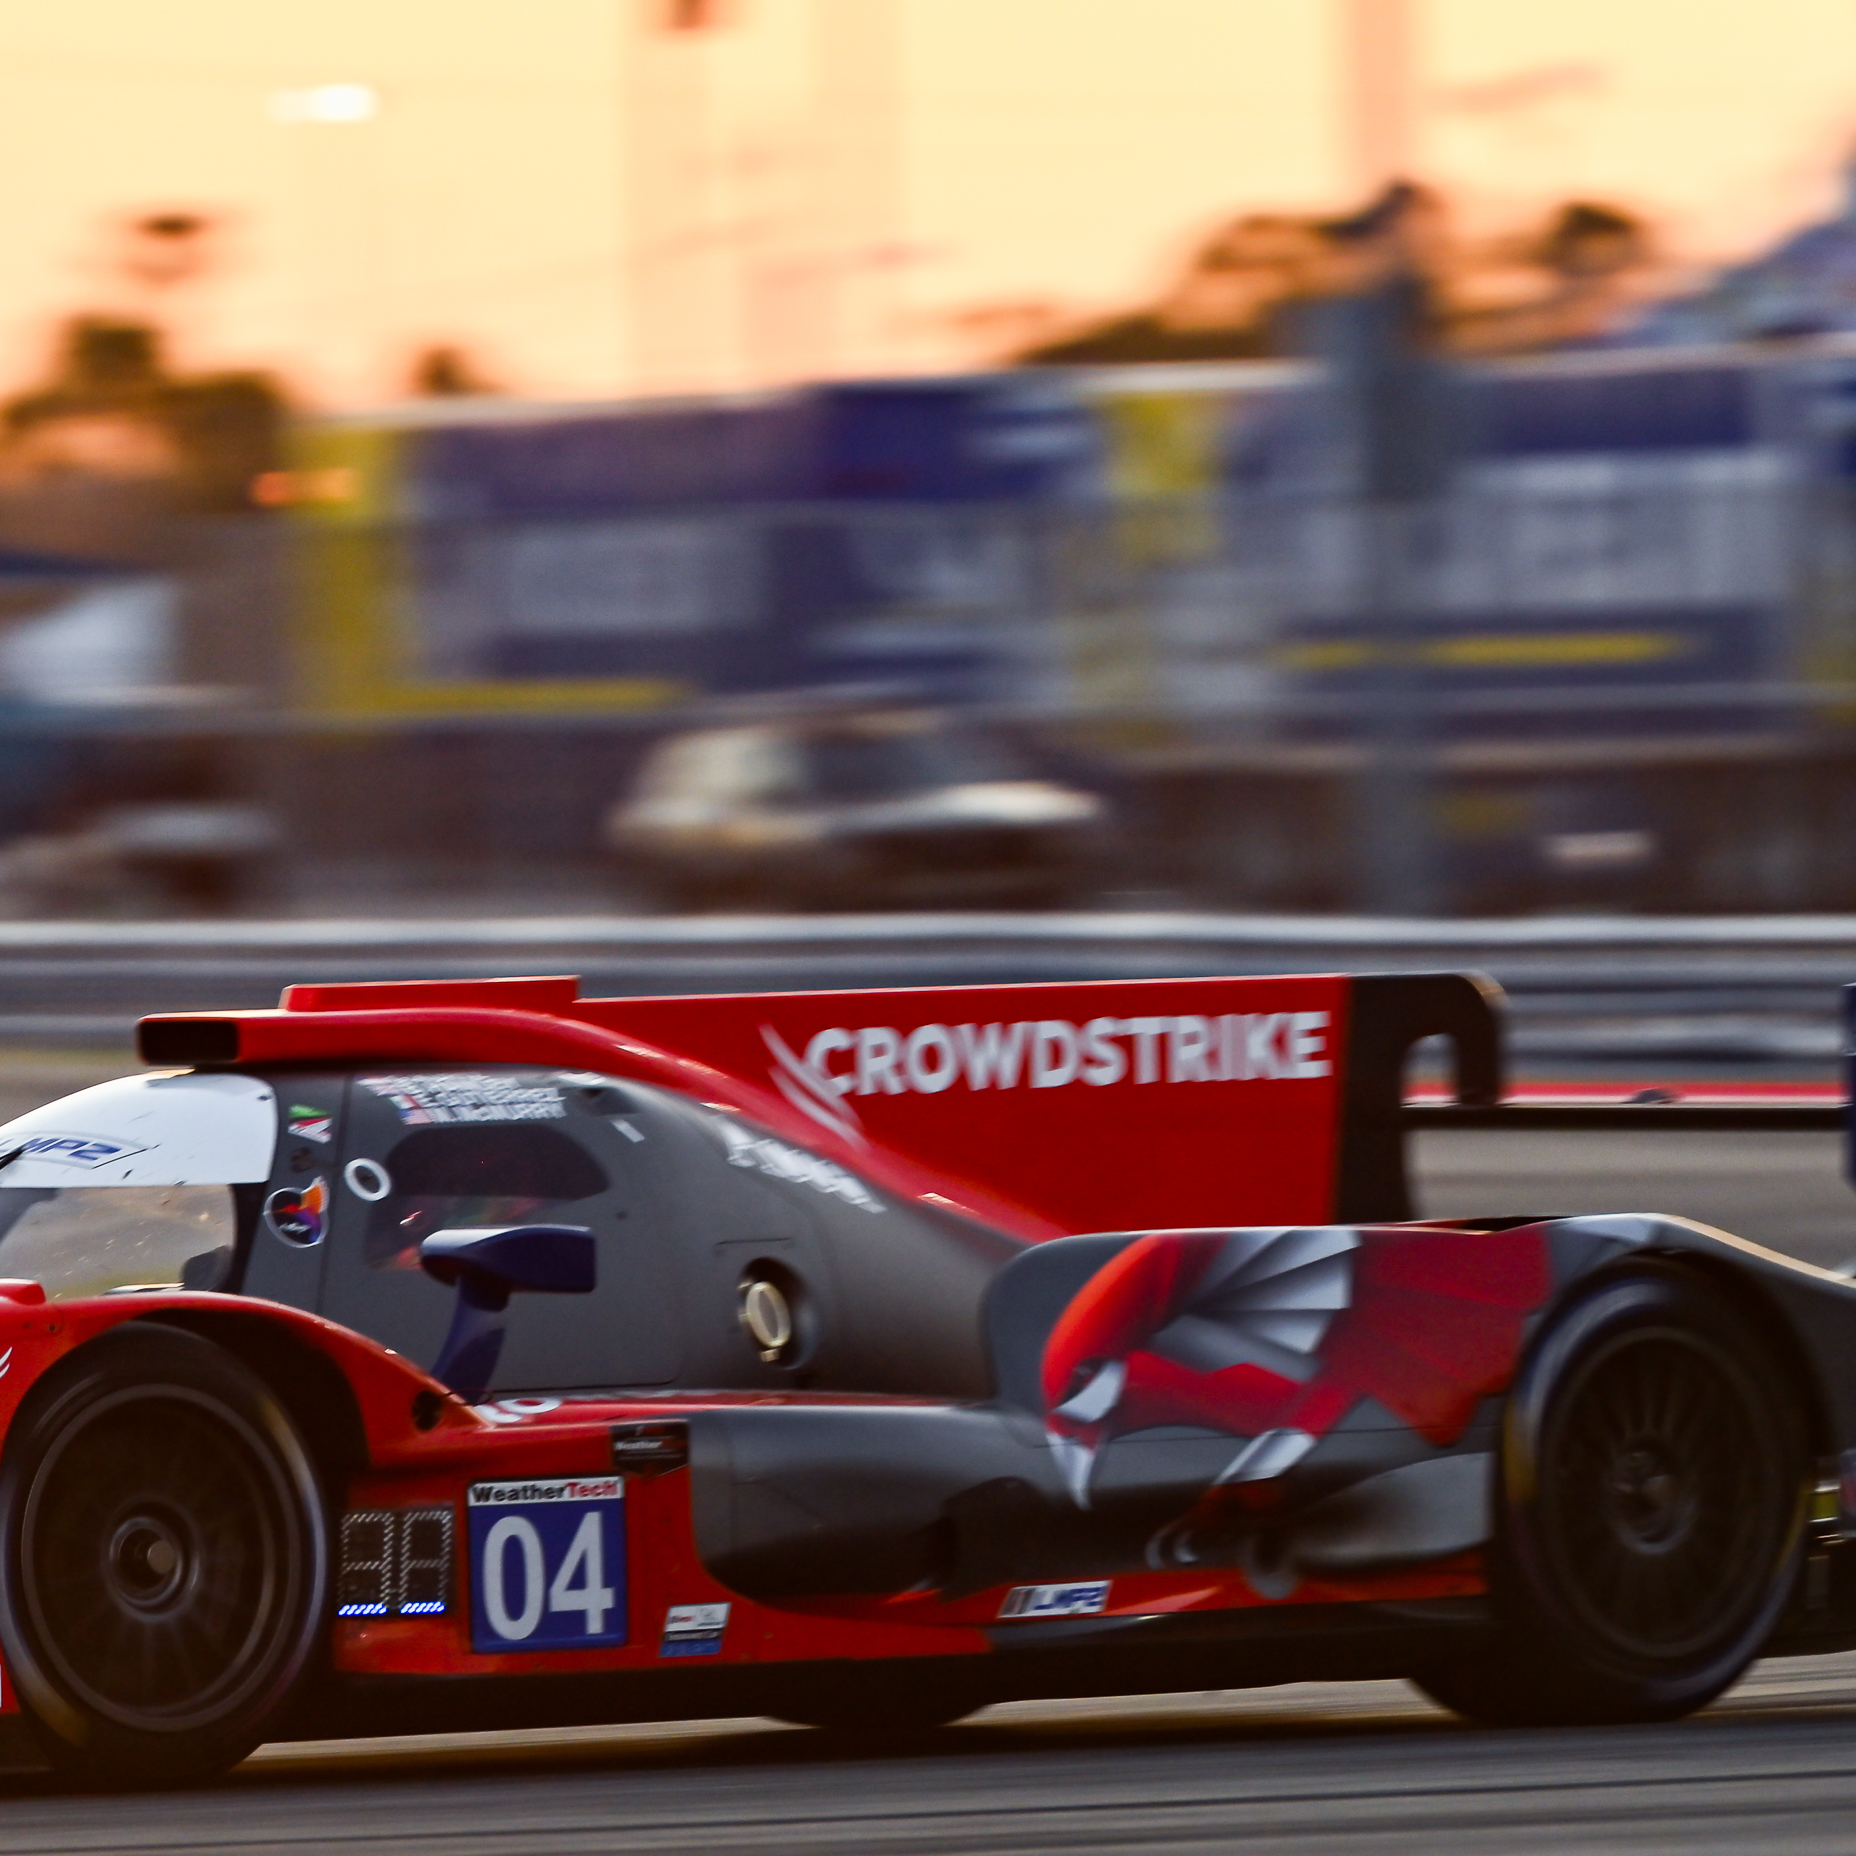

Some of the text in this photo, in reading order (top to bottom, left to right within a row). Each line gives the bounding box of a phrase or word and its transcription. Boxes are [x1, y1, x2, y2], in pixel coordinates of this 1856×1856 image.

[802, 1010, 1333, 1097] CROWDSTRIKE
[472, 1480, 617, 1502] WeatherTech
[482, 1510, 616, 1641] 04
